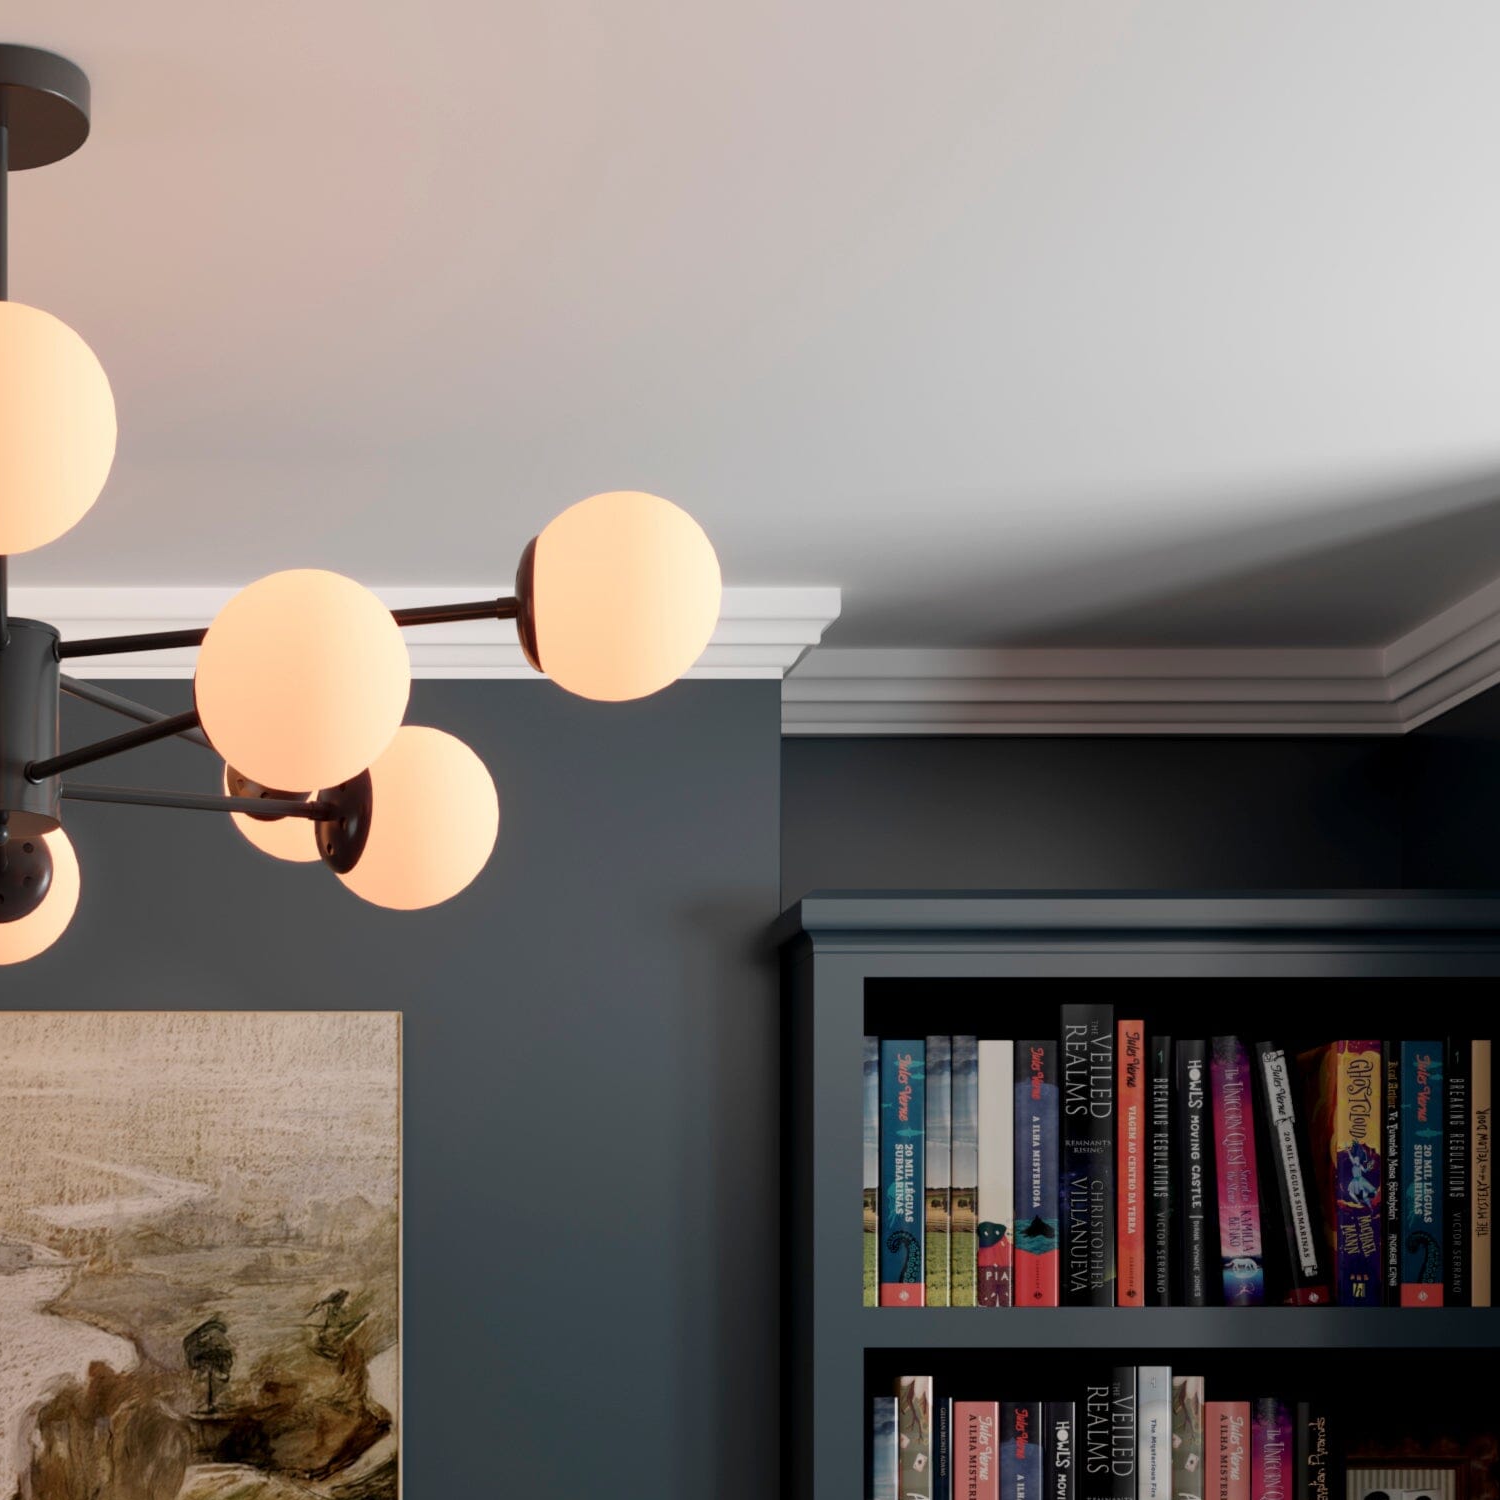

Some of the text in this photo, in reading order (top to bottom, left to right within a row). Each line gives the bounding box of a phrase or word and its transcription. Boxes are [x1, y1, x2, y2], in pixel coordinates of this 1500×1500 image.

[1065, 1025, 1088, 1116] REALMS
[1126, 1032, 1140, 1088] Jules Verne
[1128, 1106, 1136, 1234] VIAGEM AO CENTRO DA TERRA
[1154, 1078, 1168, 1197] BREAKING REGULATIONS
[1188, 1060, 1203, 1209] HOWL'S MOVING CASTLE
[1449, 1078, 1465, 1198] BREAKING REGULATIONS
[895, 1144, 904, 1215] SUBMARINAS
[1032, 1153, 1041, 1208] MISTERIOSA
[1414, 1144, 1423, 1215] SUBMARINAS
[1476, 1108, 1490, 1237] THE MYSTERY YELLOW DOOR
[1070, 1177, 1088, 1292] VILLANUEVA
[1090, 1180, 1103, 1289] CHRISTOPHER
[1156, 1213, 1165, 1293] VICTOR SERRANO
[1341, 1224, 1358, 1254] MANN
[968, 1424, 976, 1451] ILHA
[978, 1417, 992, 1480] Jules Verne
[1055, 1421, 1069, 1469] HOWL'S
[1086, 1387, 1109, 1474] REALMS
[1220, 1425, 1228, 1452] ILHA
[1221, 1414, 1228, 1422] A
[1230, 1416, 1244, 1481] Jules Verne
